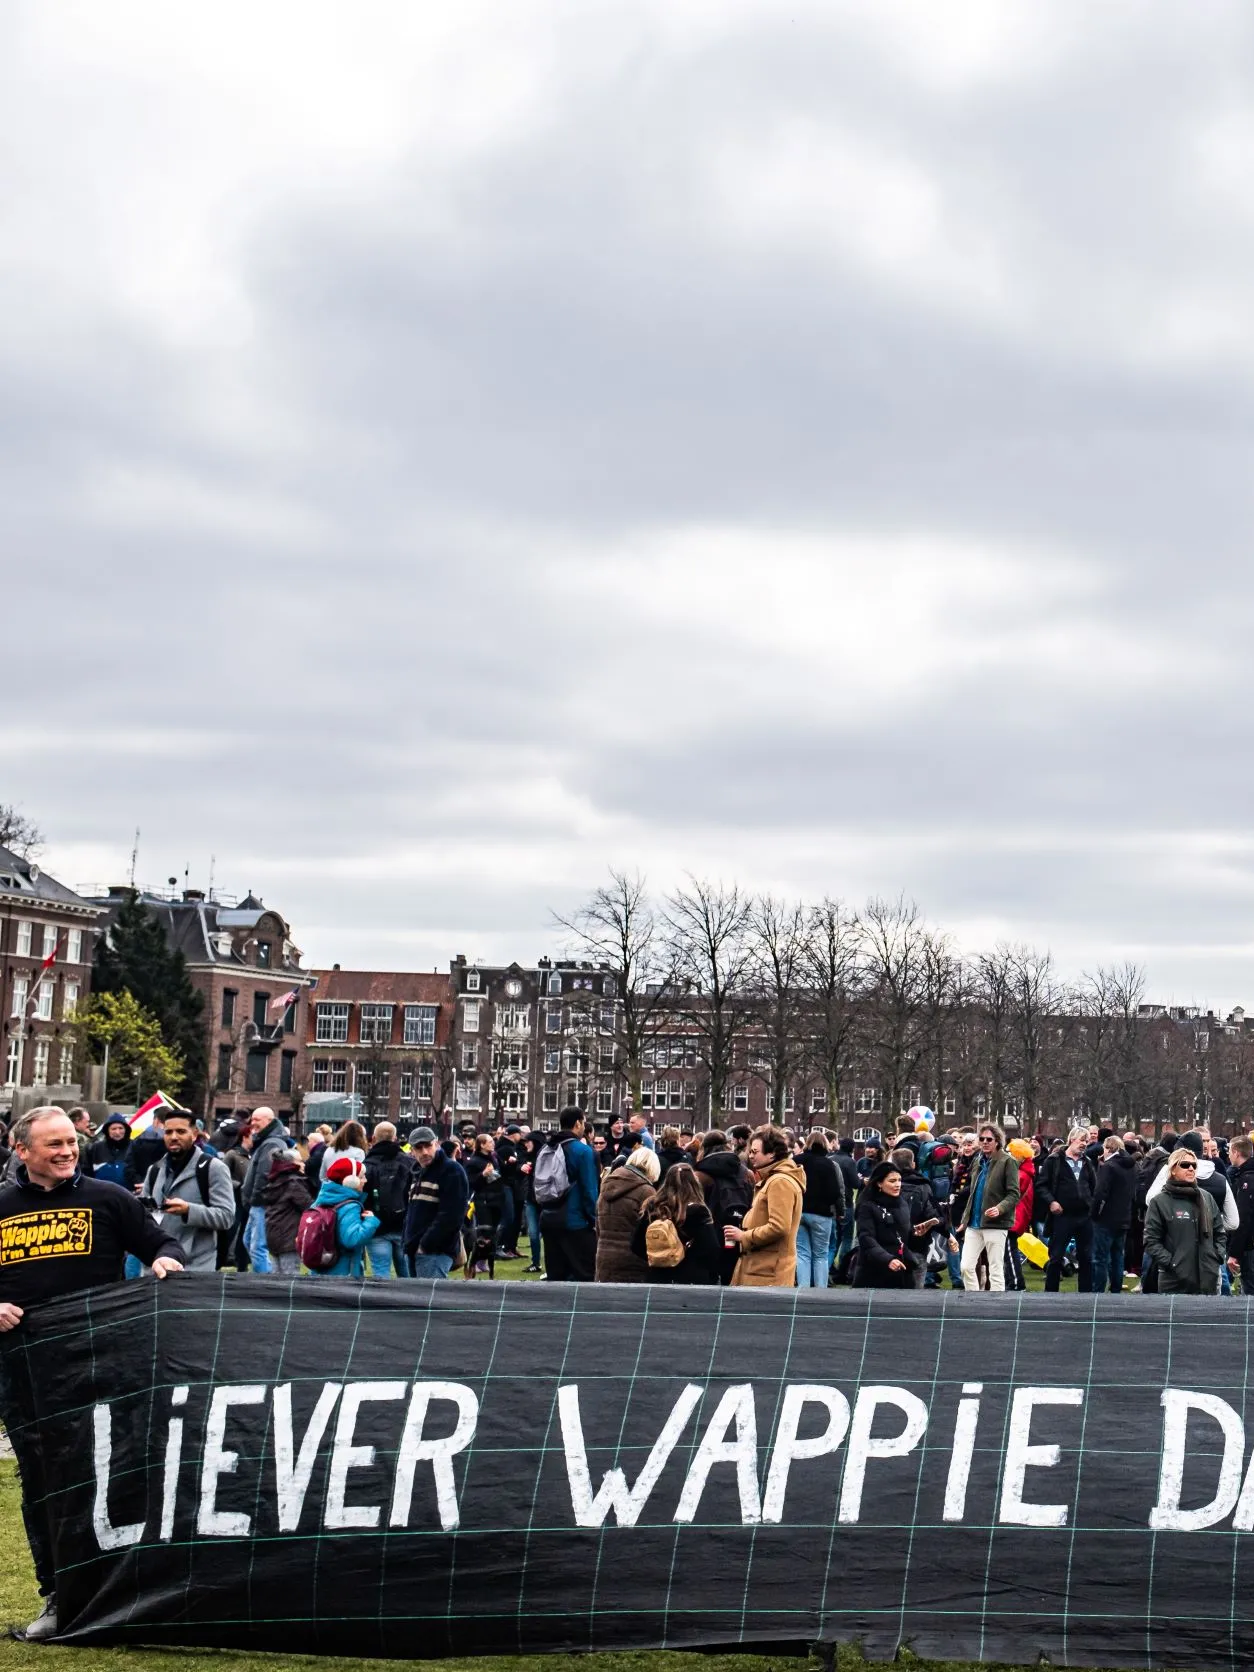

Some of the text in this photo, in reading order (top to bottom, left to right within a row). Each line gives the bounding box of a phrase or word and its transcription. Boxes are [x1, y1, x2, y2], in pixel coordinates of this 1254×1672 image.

[41, 1213, 55, 1221] to
[1, 1220, 68, 1248] Wappie
[1, 1241, 86, 1262] I'm awake
